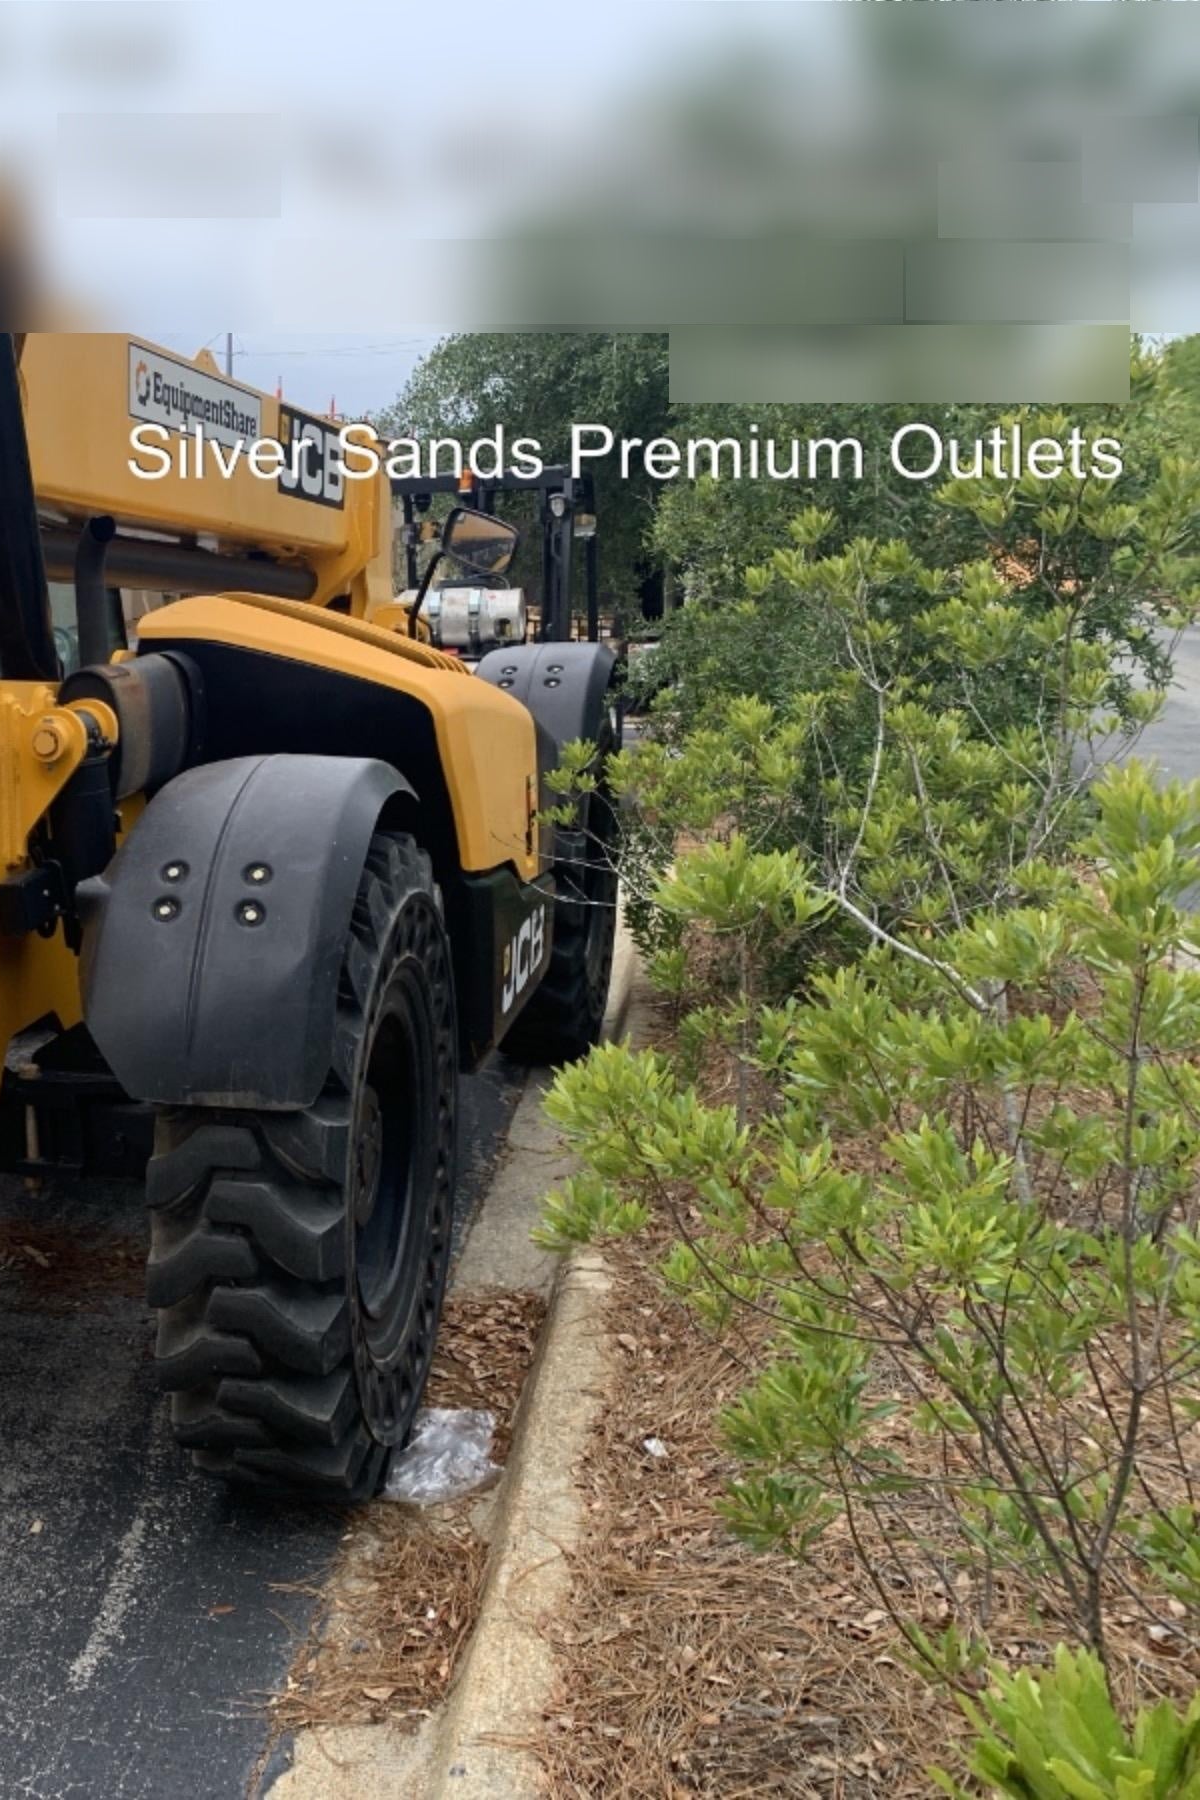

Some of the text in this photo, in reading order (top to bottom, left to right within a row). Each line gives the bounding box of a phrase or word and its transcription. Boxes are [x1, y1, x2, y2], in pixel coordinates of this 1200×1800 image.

[152, 371, 257, 438] EquipmentShare
[280, 417, 344, 502] JCB
[502, 903, 545, 1014] JCB
